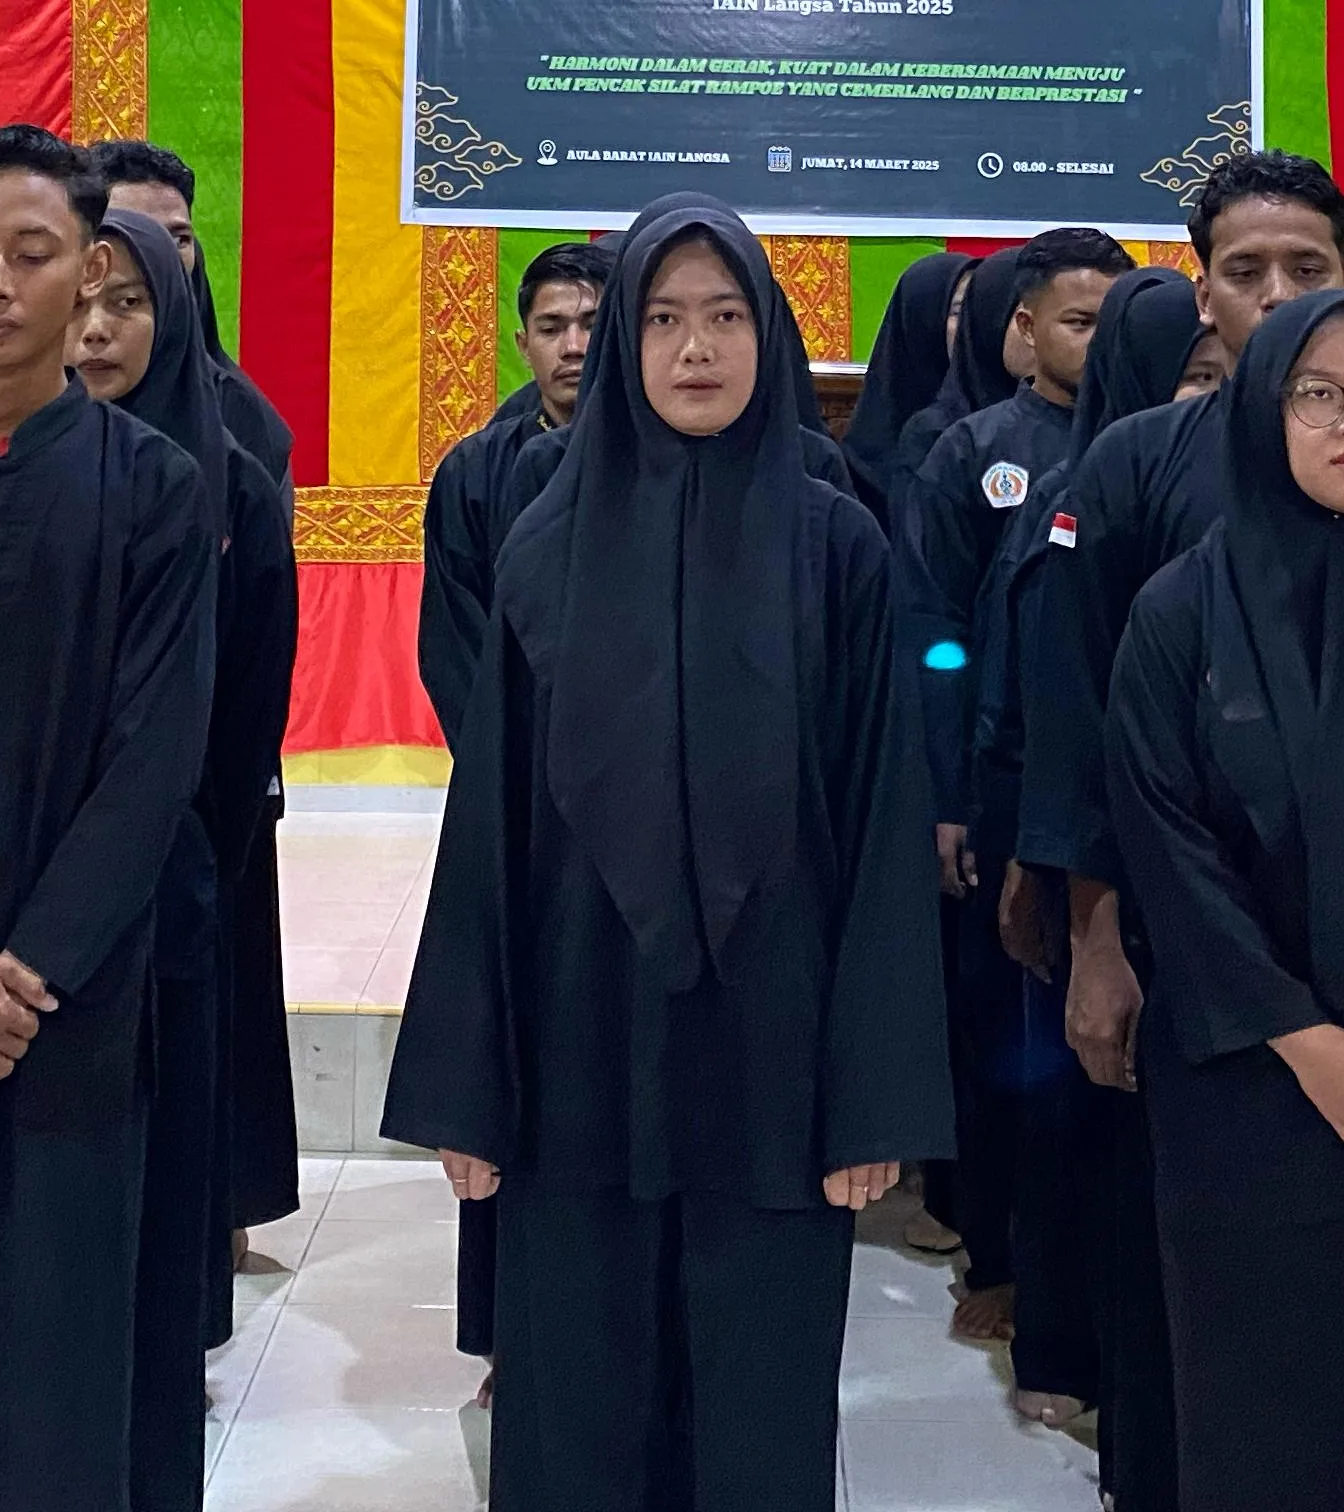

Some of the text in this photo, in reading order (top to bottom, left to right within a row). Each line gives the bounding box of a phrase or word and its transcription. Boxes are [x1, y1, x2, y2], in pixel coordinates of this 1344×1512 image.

[548, 55, 639, 72] HARMONI
[639, 57, 707, 73] DALAM
[708, 59, 775, 76] GERAK,
[777, 61, 833, 76] KUAT
[832, 61, 901, 78] DALAM
[900, 63, 1044, 80] KEBERSAMAAN
[1043, 67, 1126, 82] MENUJU
[526, 76, 573, 91] UKM
[574, 77, 647, 93] PENCAK
[647, 78, 706, 94] SILAT
[704, 80, 785, 96] RAMPOE
[786, 81, 838, 97] YANG
[839, 82, 956, 99] CEMERLANG
[955, 86, 998, 100] DAN
[996, 87, 1128, 103] BERPRESTASI
[566, 149, 730, 164] AULA BARAT IAIN LANGSA
[801, 157, 940, 171] JUMAT, 14 MARET 2025
[1012, 161, 1047, 173] 08.00
[1056, 162, 1114, 175] SELESAI
